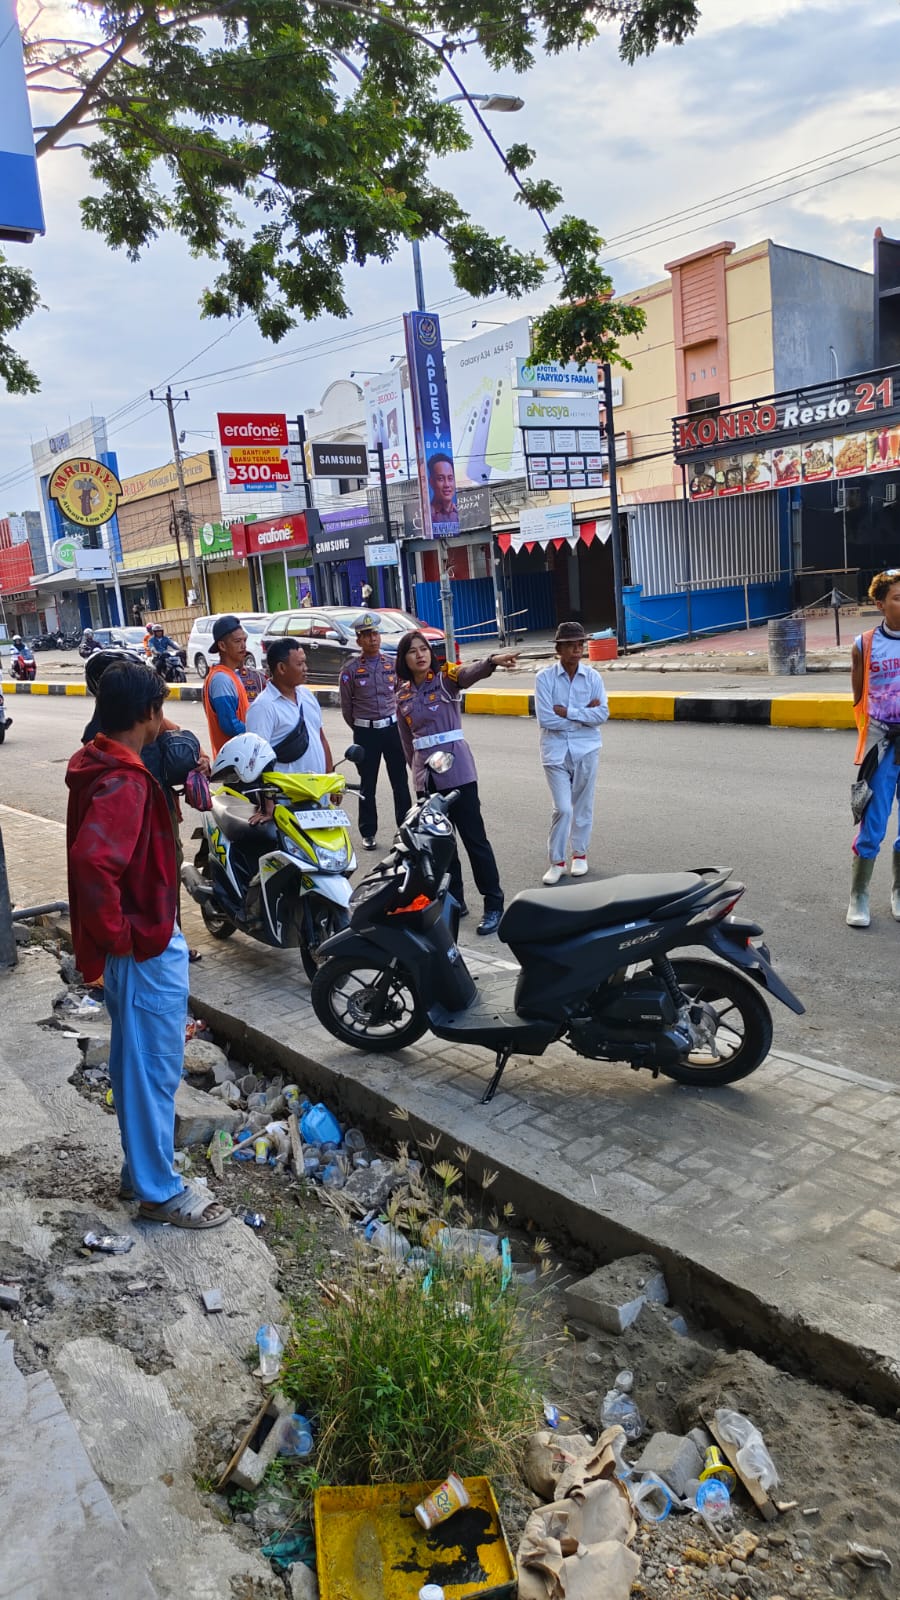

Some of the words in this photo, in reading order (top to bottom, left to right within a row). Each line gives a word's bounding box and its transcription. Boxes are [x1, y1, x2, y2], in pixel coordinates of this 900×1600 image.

[460, 355, 480, 367] Galaxy
[494, 344, 504, 354] A54
[537, 373, 569, 383] FARYKO'S
[571, 374, 595, 384] FARMA
[426, 354, 441, 425] APDES
[679, 405, 777, 448] KONRO
[783, 398, 851, 428] Resto
[854, 376, 894, 413] 21
[224, 422, 280, 437] erafone
[426, 441, 453, 449] BONE
[319, 455, 362, 465] SAMSUNG
[236, 465, 271, 481] 300
[271, 472, 289, 480] ribu
[257, 527, 290, 545] erafone
[315, 538, 349, 553] SAMSUNG
